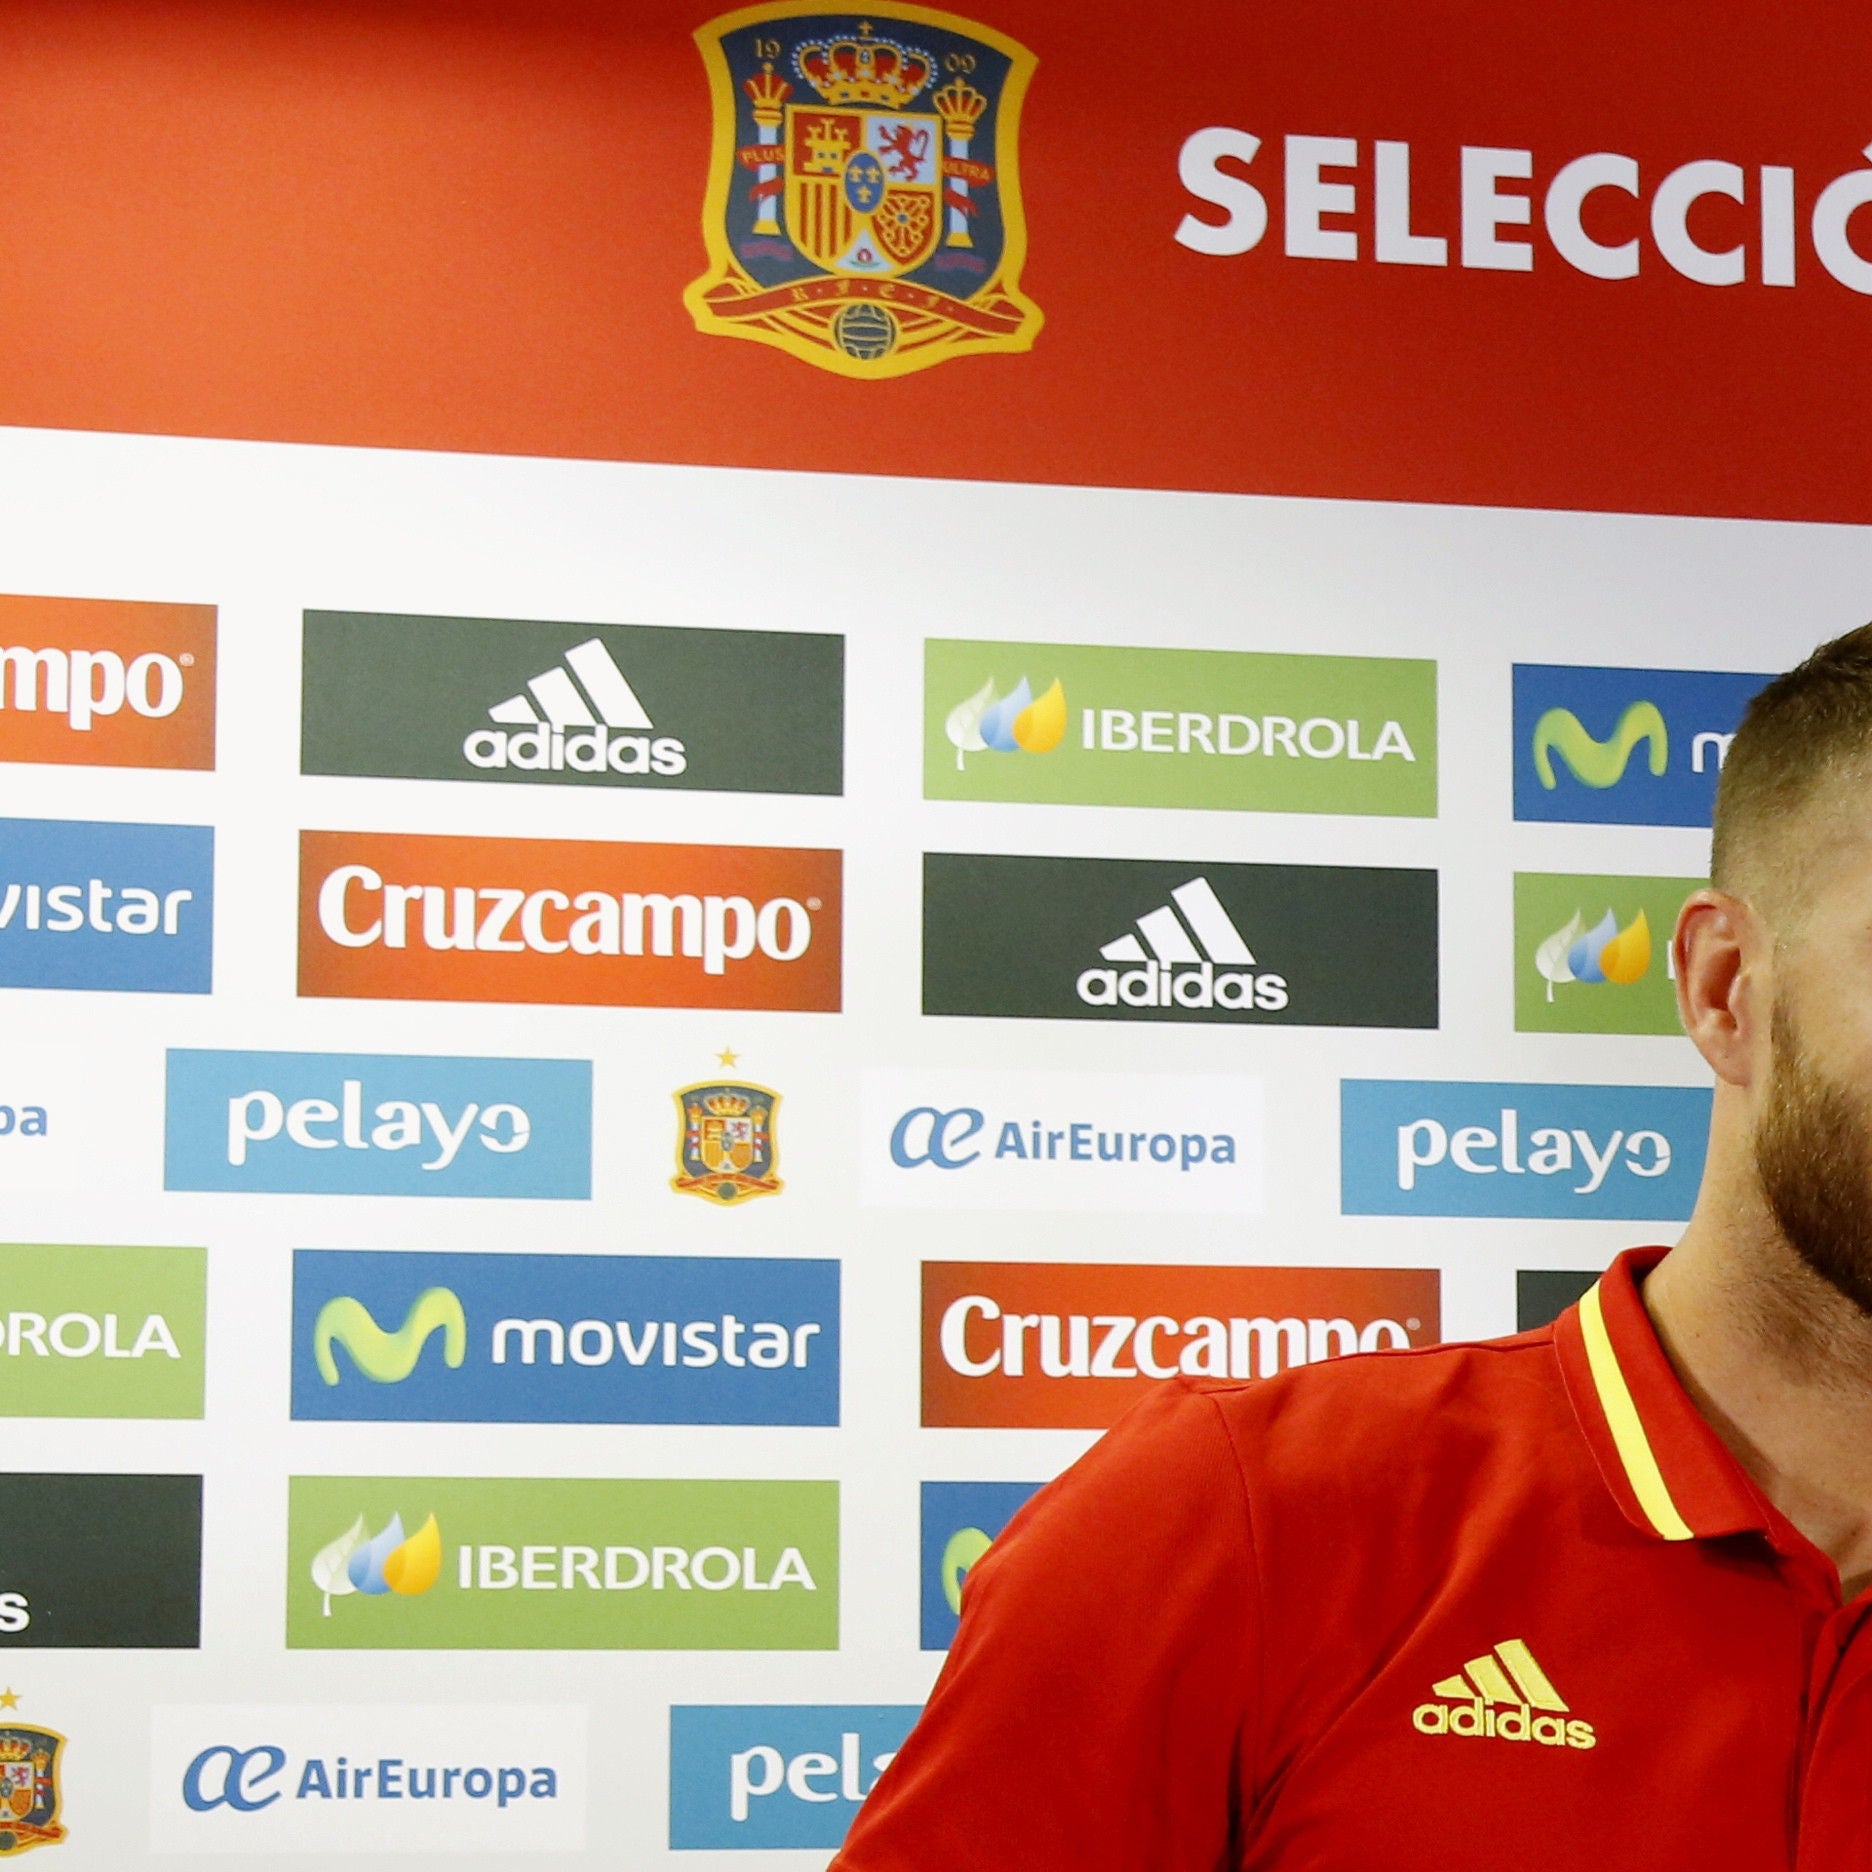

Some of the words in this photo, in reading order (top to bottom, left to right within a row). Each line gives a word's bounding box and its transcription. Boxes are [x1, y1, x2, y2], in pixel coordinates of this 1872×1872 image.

[464, 724, 687, 776] adidas
[1082, 706, 1416, 763] IBERDROLA
[319, 864, 811, 975] Cruzcampo
[1076, 960, 1288, 1011] adidas
[228, 1080, 530, 1170] pelayo
[995, 1120, 1236, 1174] AirEuropa
[1398, 1108, 1671, 1193] pelayo
[492, 1314, 820, 1368] movistar
[459, 1545, 817, 1590] IBERDROLA
[1412, 1697, 1597, 1750] adidas
[297, 1758, 557, 1808] AirEuropa
